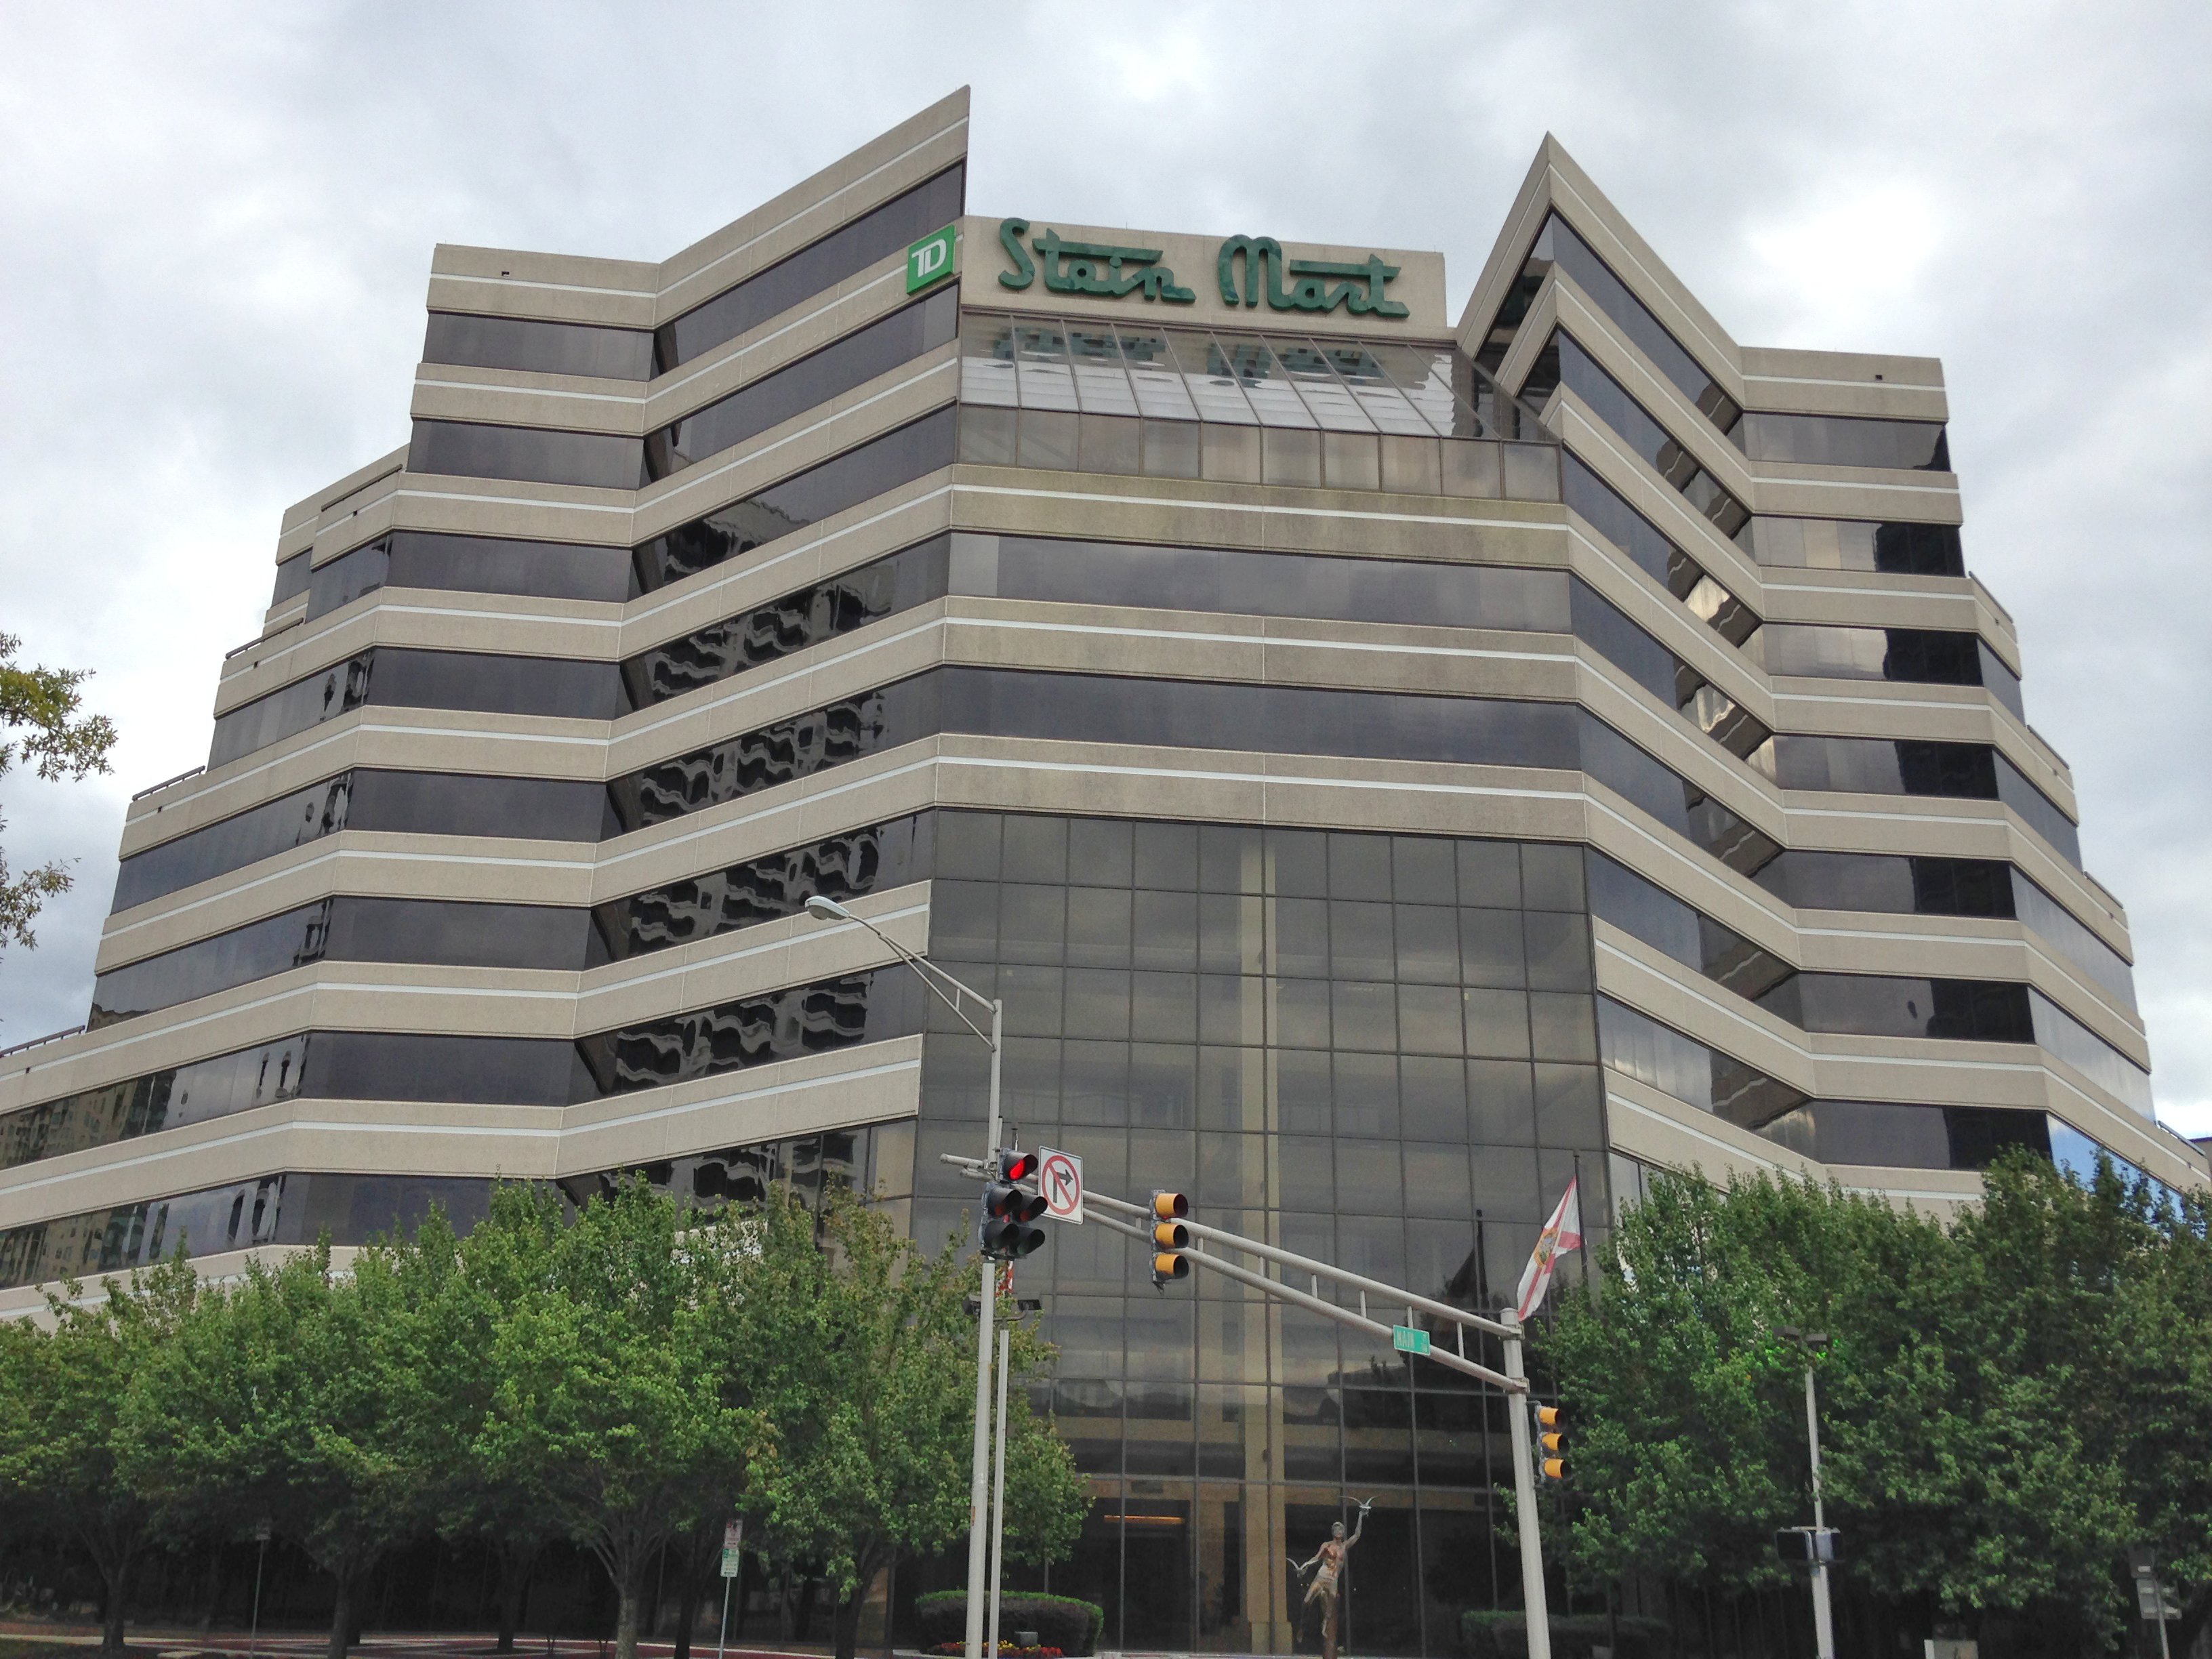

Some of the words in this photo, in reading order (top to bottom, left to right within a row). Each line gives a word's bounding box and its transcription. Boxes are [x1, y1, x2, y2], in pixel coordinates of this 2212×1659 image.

[911, 239, 947, 278] TD
[998, 217, 1197, 304] Stein
[1218, 234, 1411, 319] Mart
